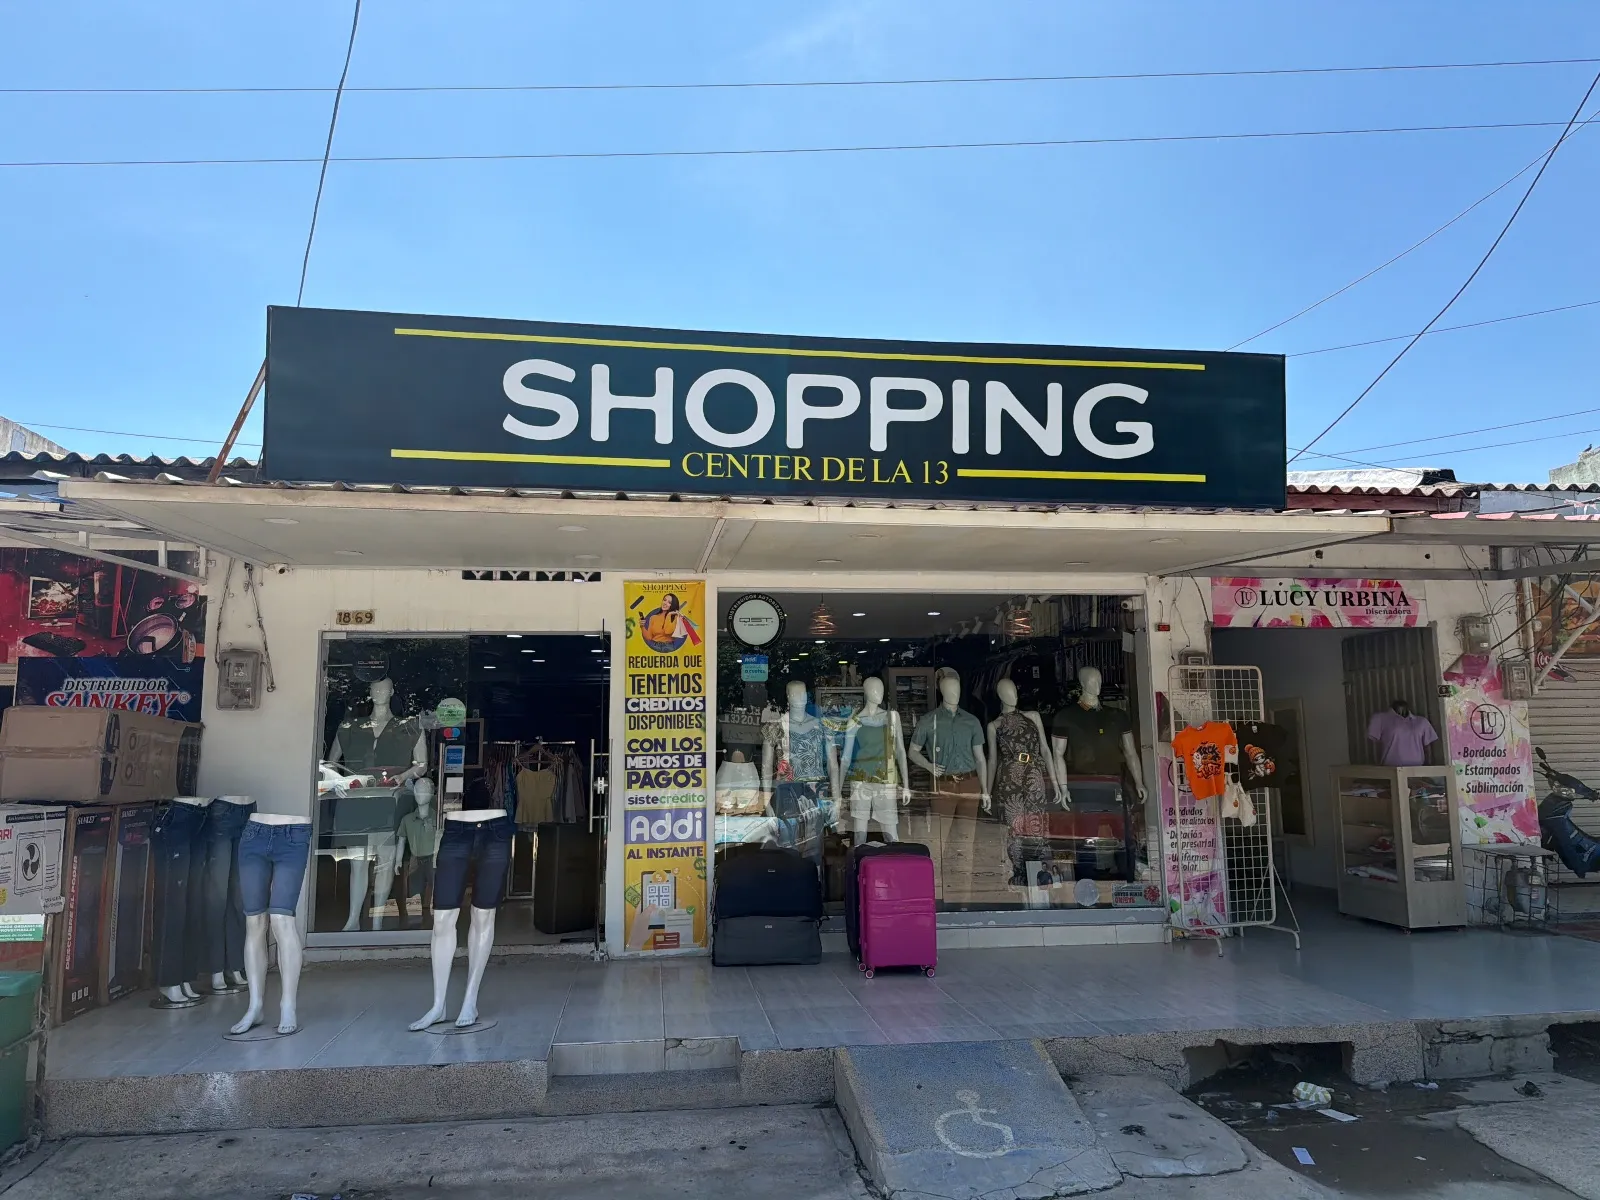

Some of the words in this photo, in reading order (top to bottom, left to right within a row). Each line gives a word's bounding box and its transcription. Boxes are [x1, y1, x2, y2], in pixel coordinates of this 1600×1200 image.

[502, 358, 1155, 459] SHOPPING
[681, 452, 815, 481] CENTER
[821, 456, 867, 483] DE
[871, 458, 914, 484] LA
[922, 460, 949, 485] 13
[1260, 590, 1317, 607] LUCY
[1325, 590, 1412, 607] URBINA
[337, 611, 374, 624] 1869
[628, 655, 679, 668] RECUERDA
[683, 655, 702, 668] QUE
[64, 679, 167, 691] DISTRIBUIDOR
[628, 672, 703, 695] TENEMOS
[627, 696, 704, 712] CREDITOS
[628, 713, 703, 730] DISPONIBLES
[627, 737, 667, 753] CON
[671, 736, 703, 752] LOS
[1462, 746, 1507, 758] Bordados
[626, 755, 681, 769] MEDIOS
[684, 754, 703, 768] DE
[1464, 763, 1521, 778] Estampados
[626, 769, 703, 790] PAGOS
[1465, 780, 1524, 794] Sublimación
[630, 810, 703, 842] Addi
[627, 849, 643, 860] AL
[646, 846, 704, 859] INSTANTE
